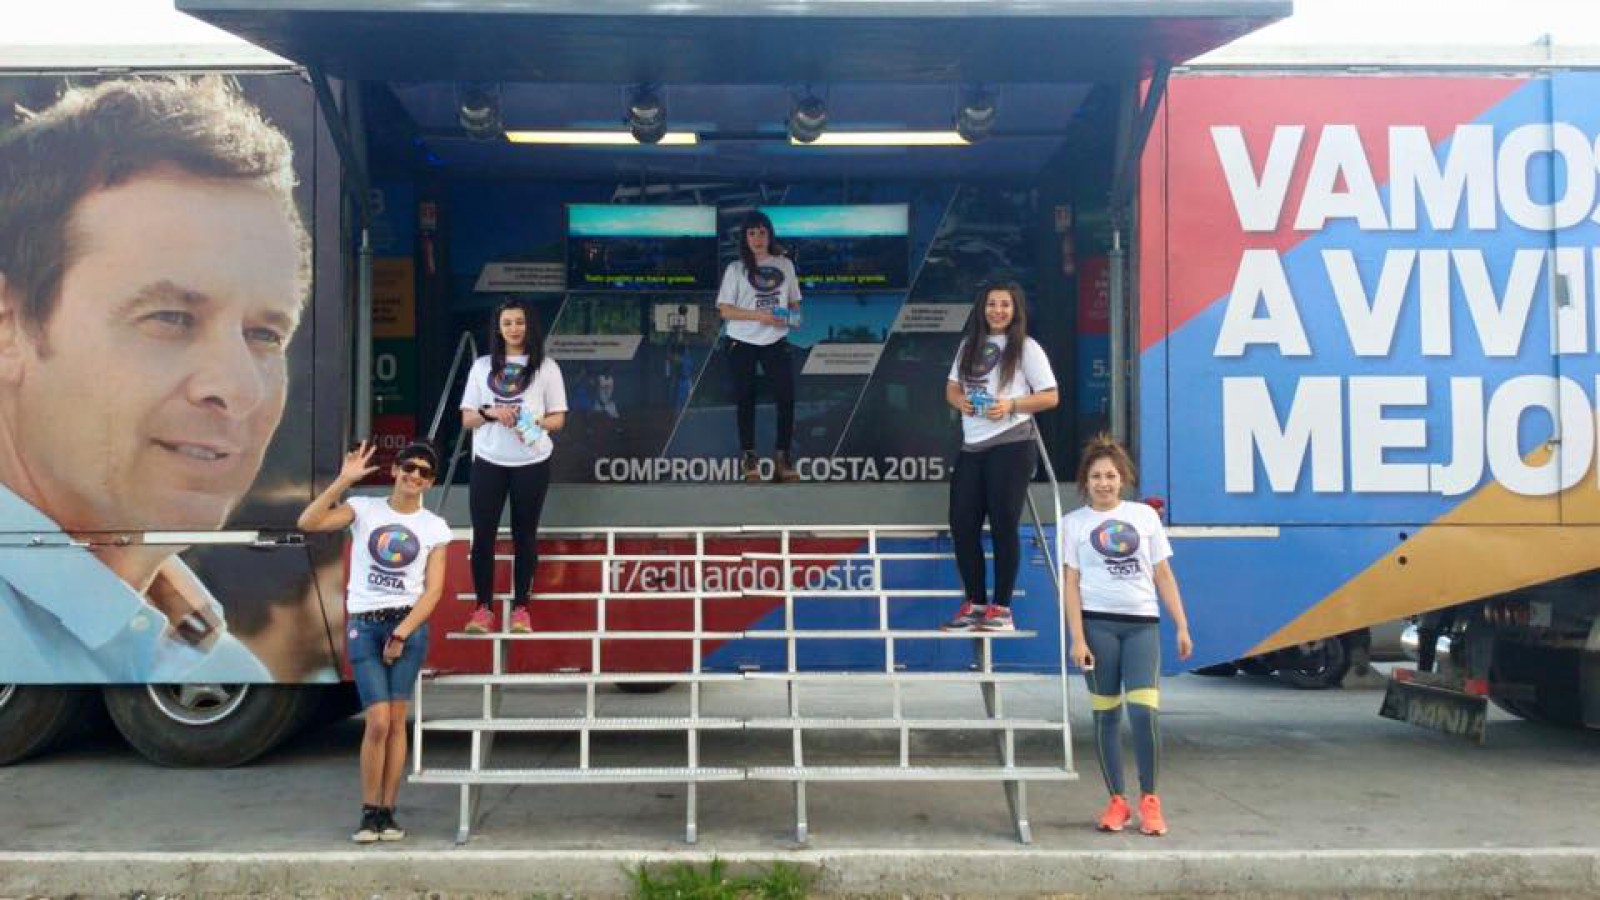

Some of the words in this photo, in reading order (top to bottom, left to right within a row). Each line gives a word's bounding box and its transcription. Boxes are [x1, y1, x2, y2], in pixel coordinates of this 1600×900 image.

[1209, 122, 1600, 233] VAMO
[1212, 248, 1313, 357] A
[1320, 246, 1600, 357] VIVI
[594, 456, 775, 481] COMPROMIO
[796, 456, 879, 481] COSTA
[884, 456, 944, 481] 2015
[1222, 373, 1600, 496] MEJO
[367, 572, 406, 590] COSTA
